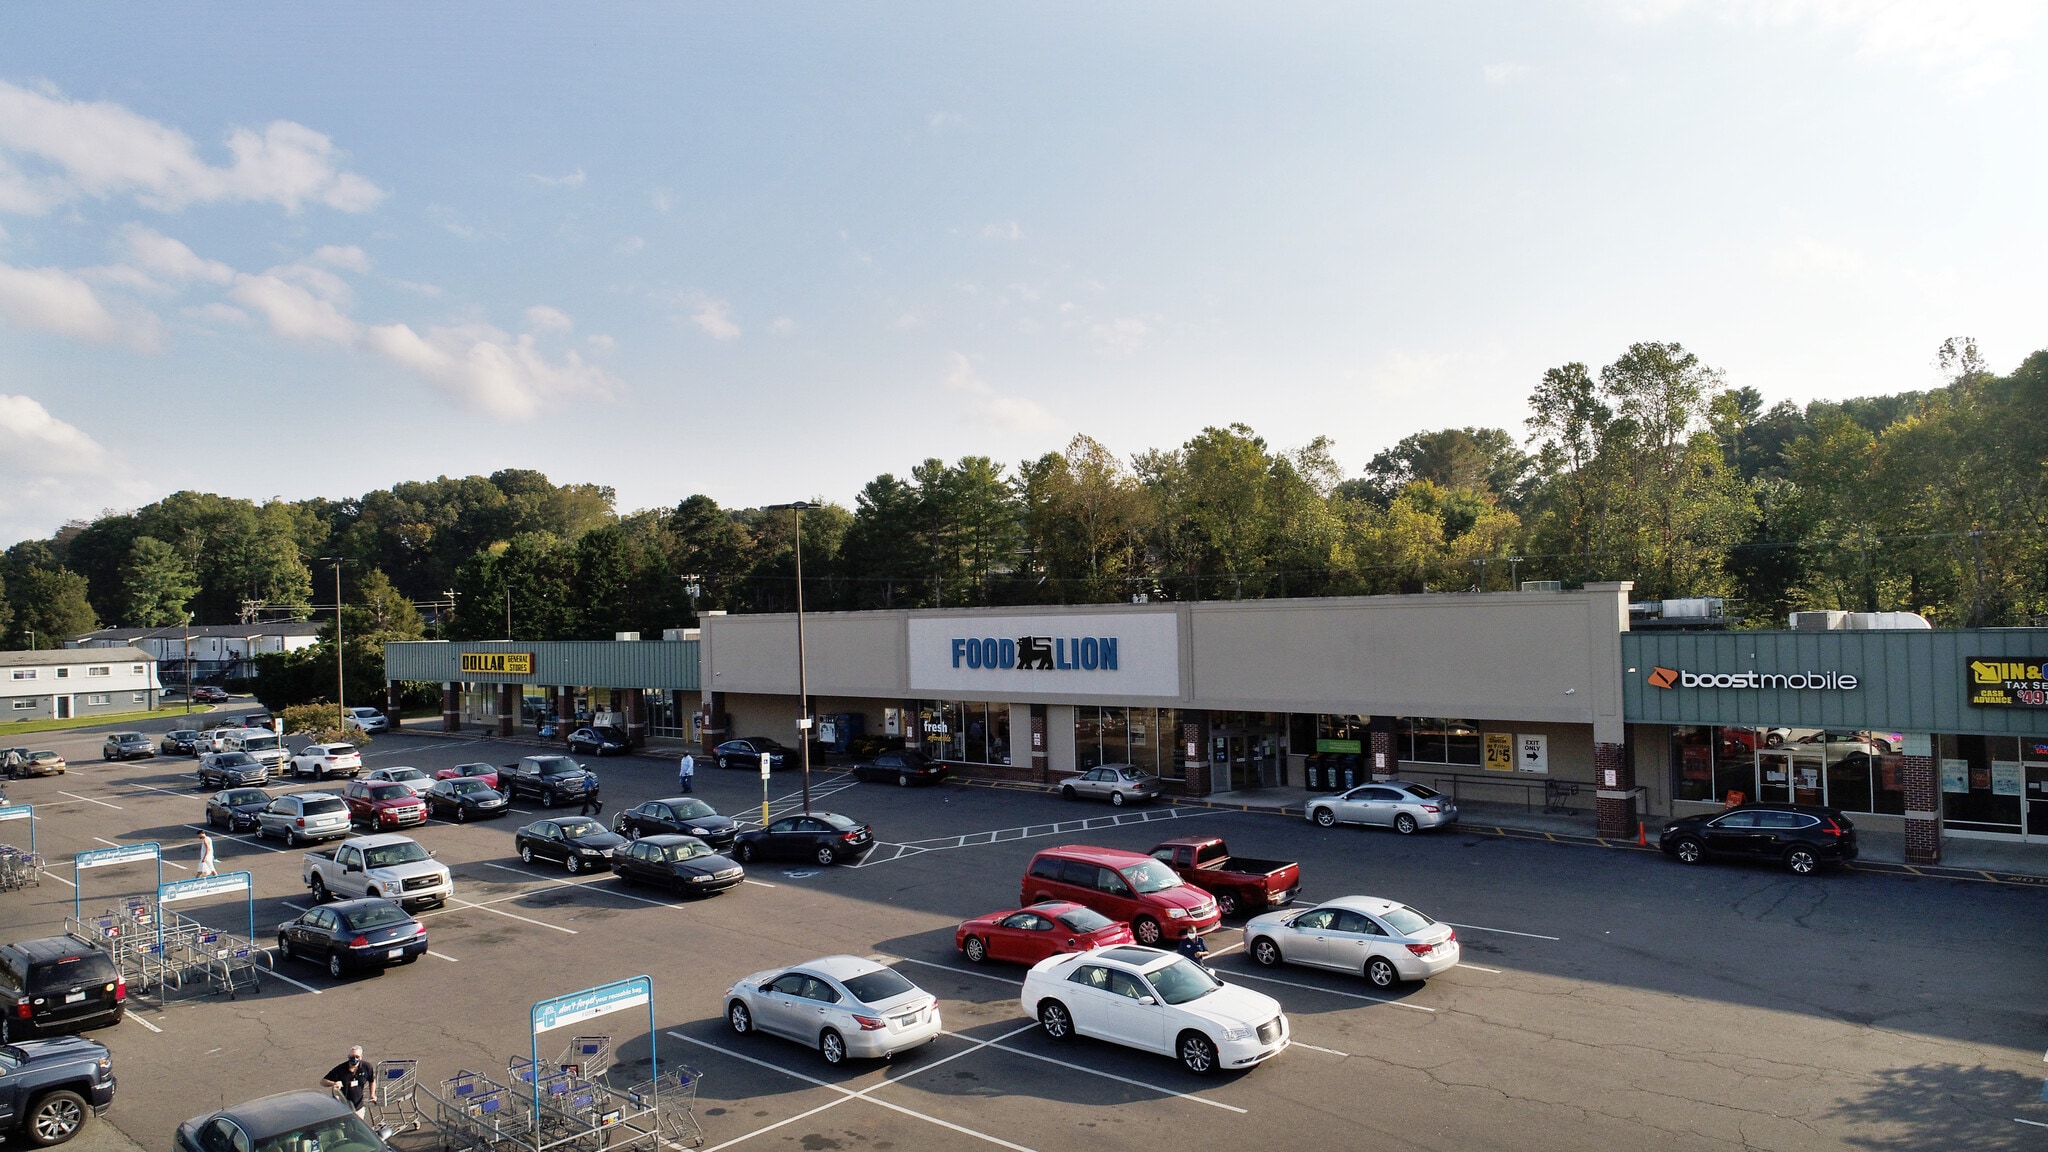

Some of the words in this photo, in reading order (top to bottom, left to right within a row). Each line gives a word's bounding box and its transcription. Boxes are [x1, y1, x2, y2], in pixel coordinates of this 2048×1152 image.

[951, 637, 1014, 669] FOOD
[1055, 636, 1118, 670] LION
[462, 655, 504, 671] DOLLAR
[2005, 681, 2028, 689] TAX
[2016, 689, 2045, 705] $49
[923, 720, 948, 733] fresh
[558, 1002, 577, 1014] don't
[576, 994, 597, 1011] forget
[595, 996, 608, 1004] your
[608, 988, 631, 1000] reusable
[632, 986, 643, 994] bag
